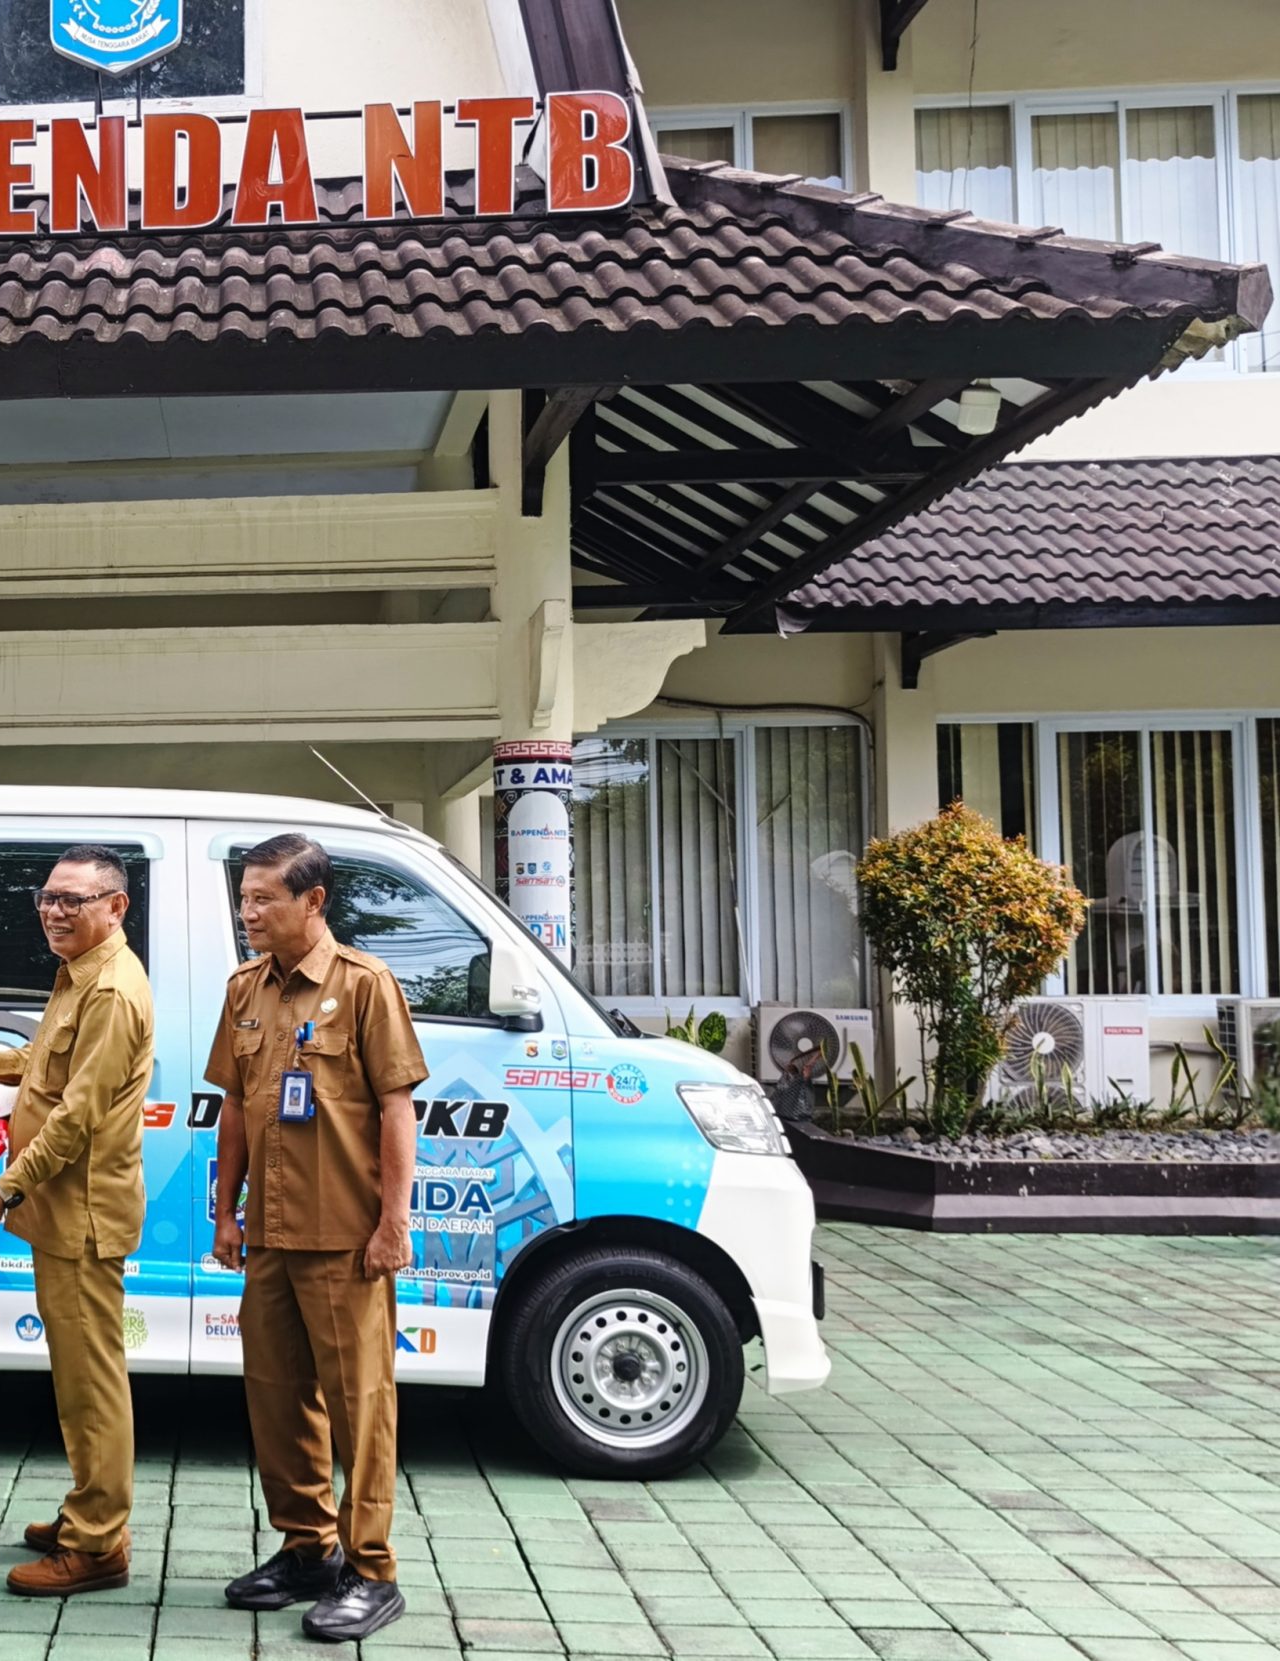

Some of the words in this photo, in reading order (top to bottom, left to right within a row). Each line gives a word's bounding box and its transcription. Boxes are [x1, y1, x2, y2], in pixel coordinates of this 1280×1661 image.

[361, 90, 635, 218] NTB
[510, 767, 526, 785] &
[461, 1168, 494, 1178] BARAT
[427, 1218, 493, 1233] DAERAH
